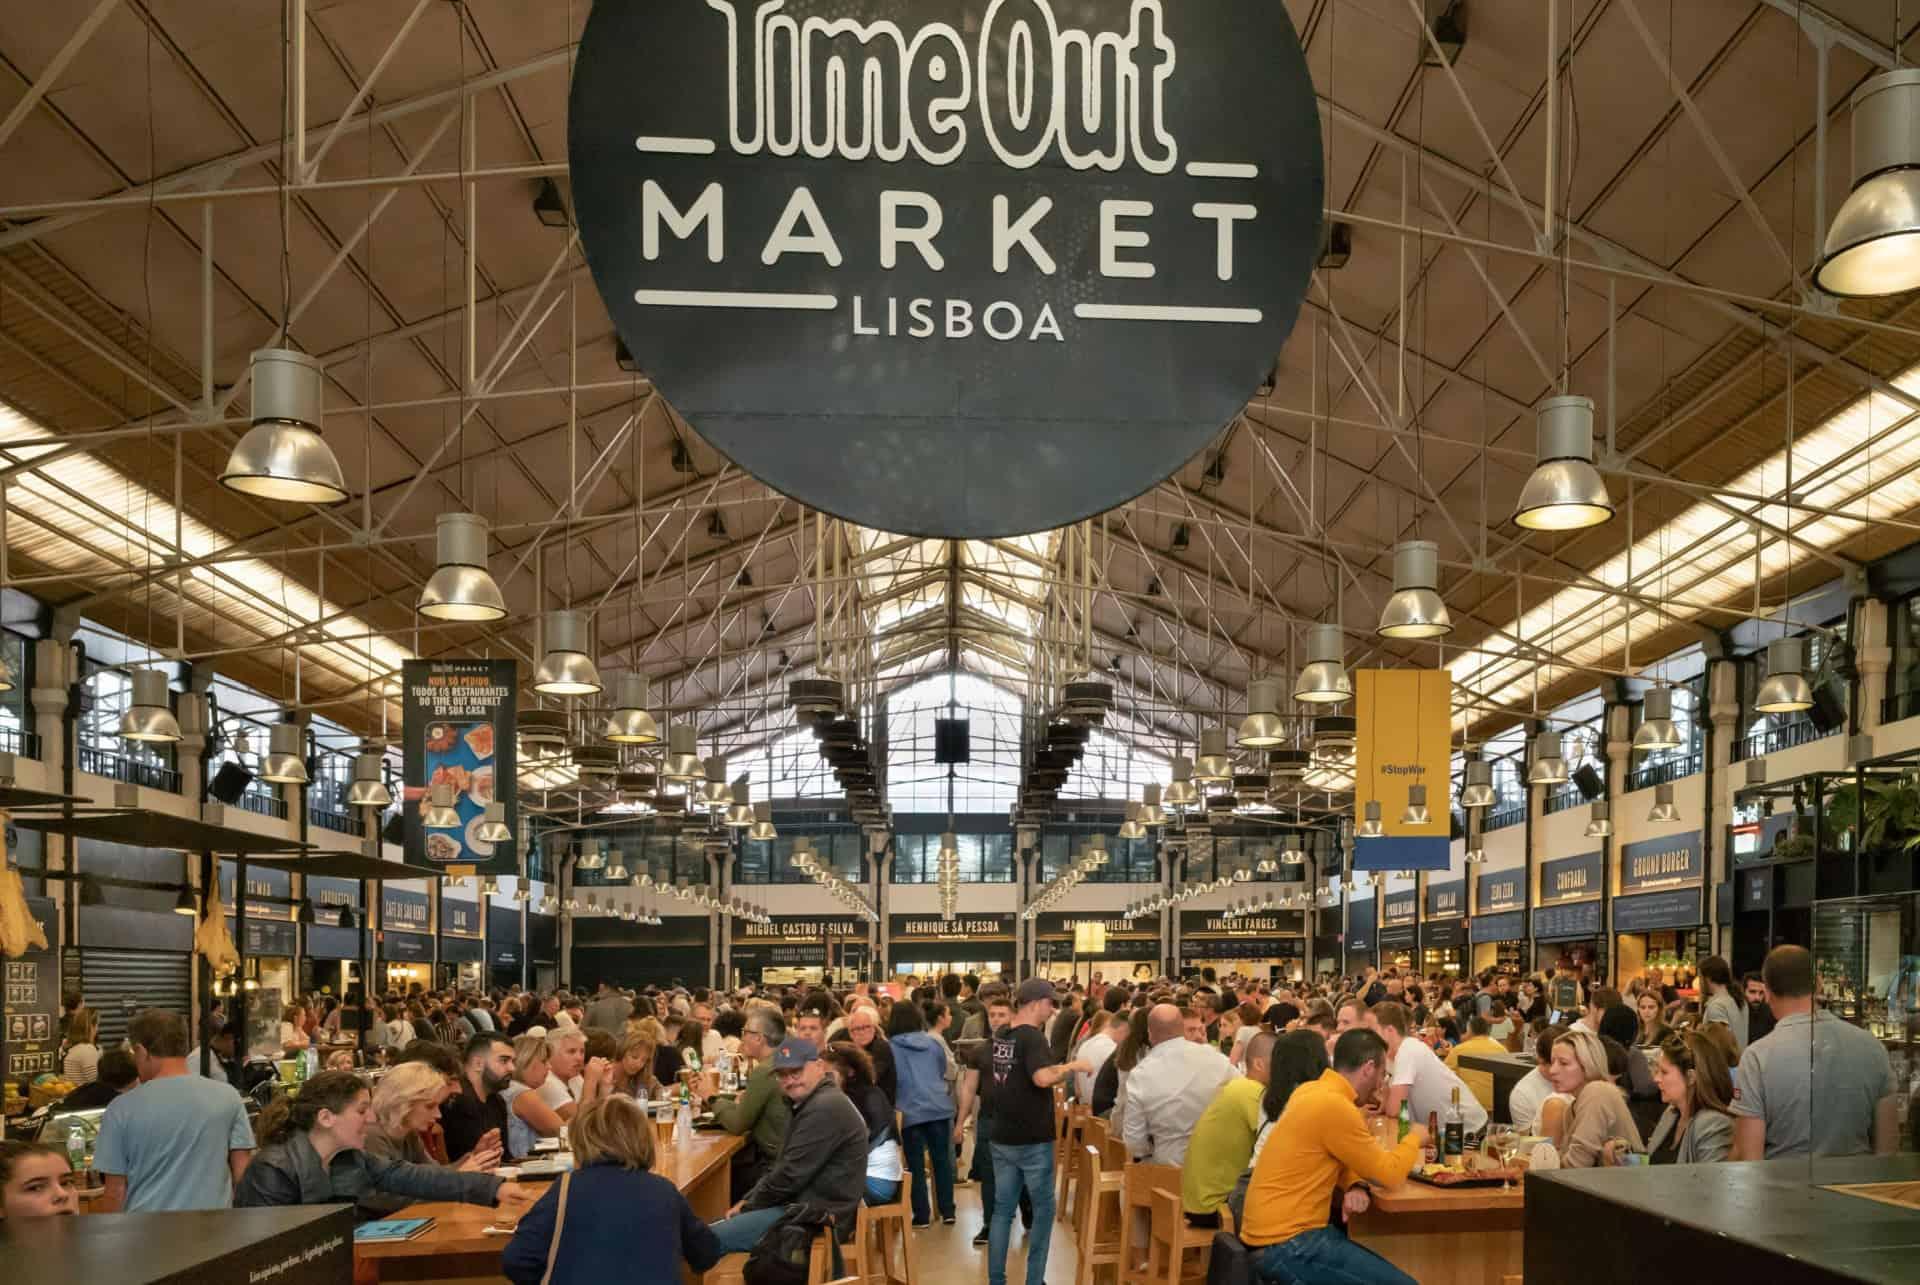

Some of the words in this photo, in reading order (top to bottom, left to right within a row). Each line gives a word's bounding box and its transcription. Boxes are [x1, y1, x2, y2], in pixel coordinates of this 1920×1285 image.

[641, 178, 1258, 281] MARKET
[852, 295, 1065, 342] LISBOA
[412, 687, 437, 697] TODOS
[439, 687, 449, 697] OS
[451, 687, 508, 697] RESTAURANTES
[419, 696, 430, 706] DO
[432, 696, 451, 706] TIME
[453, 696, 467, 706] OUT
[470, 696, 502, 706] MARKET
[434, 706, 447, 716] EM
[448, 706, 464, 716] SUA
[465, 706, 487, 716] CASA
[1662, 848, 1690, 873] BURGER
[746, 923, 779, 936] MIGUEL
[782, 923, 817, 935] CASTRO
[905, 920, 949, 933] HENRIQUE
[951, 919, 964, 933] SÁ
[966, 920, 999, 933] PESSOA
[1104, 919, 1134, 931] VIEIRA
[1207, 918, 1243, 930] VINCENT
[1245, 918, 1278, 929] FARGES
